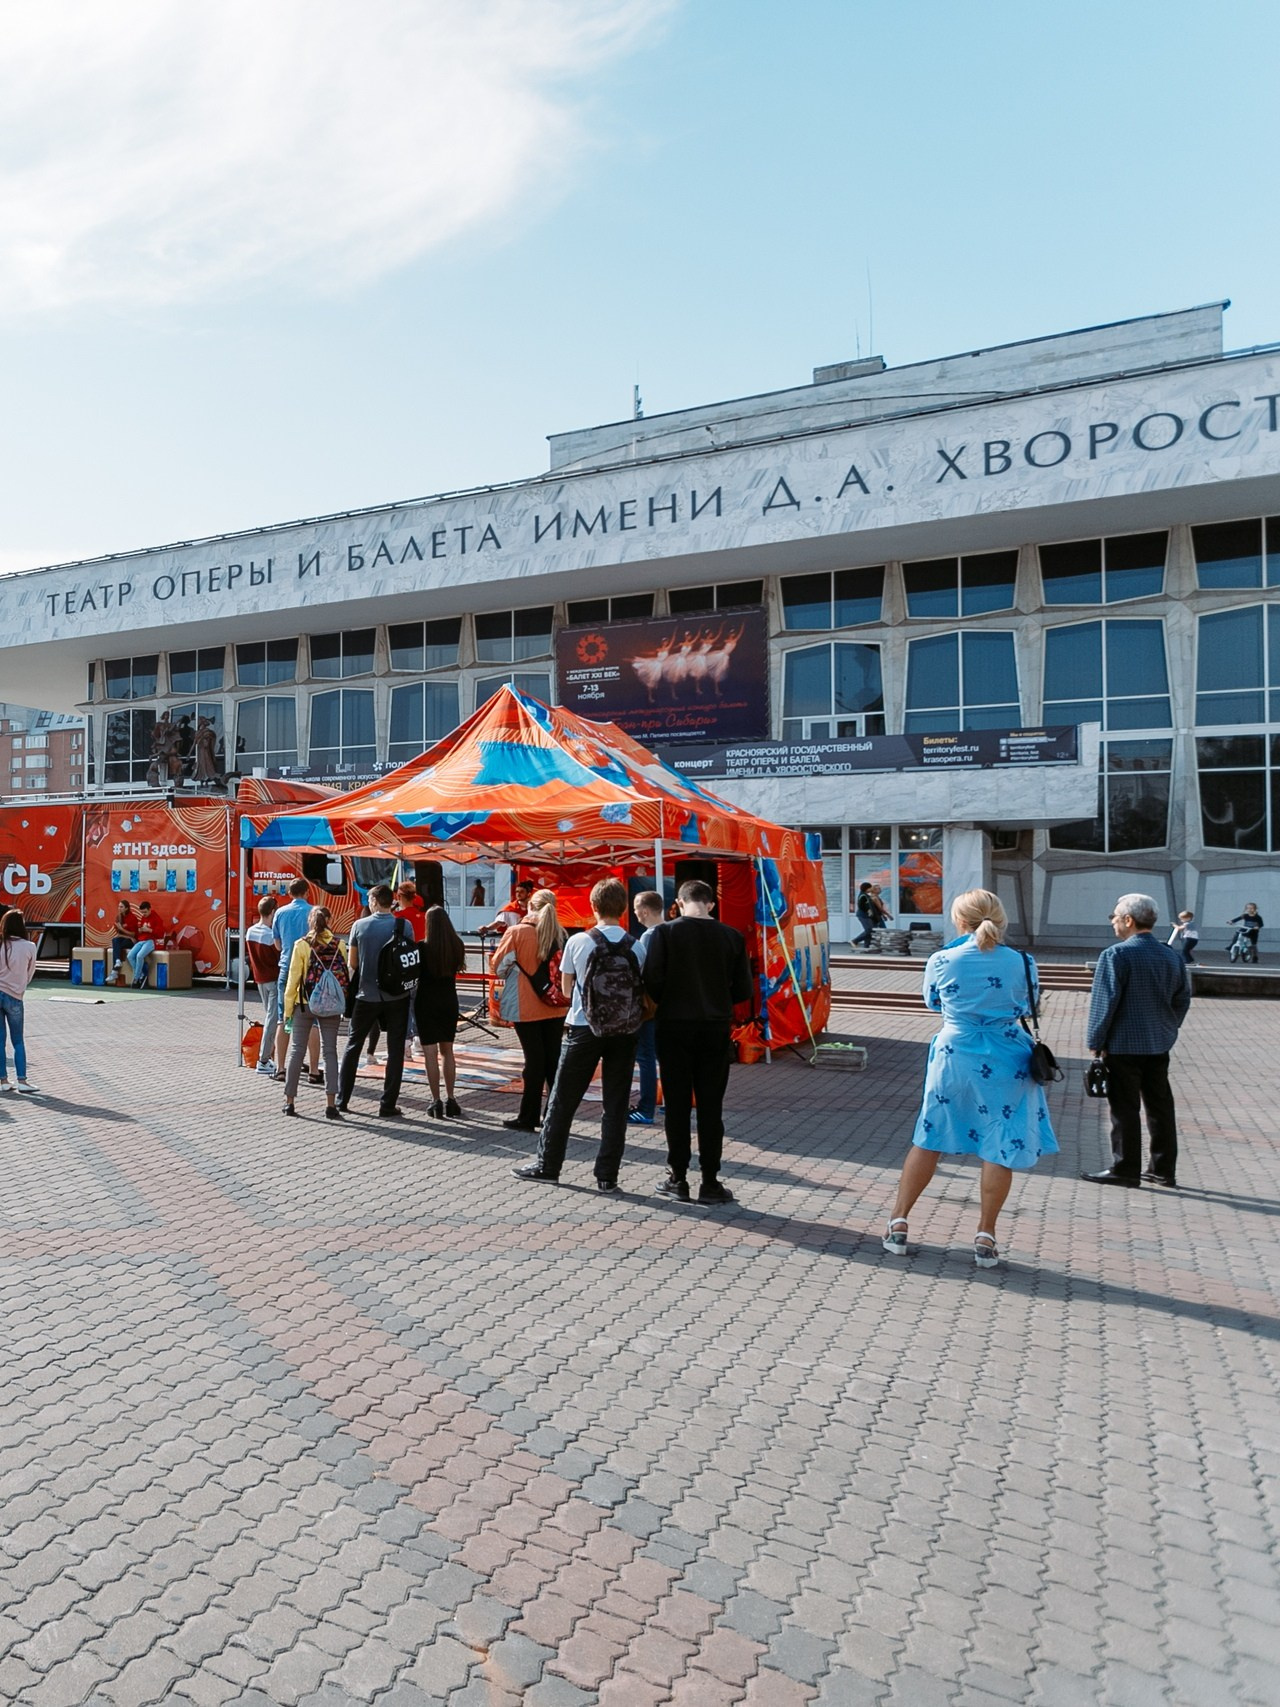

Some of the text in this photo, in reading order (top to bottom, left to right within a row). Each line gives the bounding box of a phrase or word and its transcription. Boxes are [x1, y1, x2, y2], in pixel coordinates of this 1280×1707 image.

[47, 582, 132, 616] ТЕАТР
[153, 558, 272, 601] ОПЕРЫ
[298, 551, 320, 579] И
[348, 523, 502, 571] БАЛЕТА
[534, 486, 722, 544] ИМЕНИ
[582, 684, 599, 692] 7-13
[577, 691, 605, 700] ноября
[726, 741, 873, 758] КРАСНОЯРСКИЙ ГОСУДАРСТВЕННЫЙ
[923, 744, 980, 755] territoryfest.ru
[674, 758, 714, 769] концерт
[726, 754, 821, 767] ТЕАТР ОПЕРЫ И БАЛЕТА
[923, 754, 973, 764] krasopera.ru
[726, 766, 755, 776] ИМЕНИ
[112, 841, 196, 856] #ТНТздесь
[111, 858, 197, 893] ТНТ
[253, 871, 296, 879] #ТНТздесь
